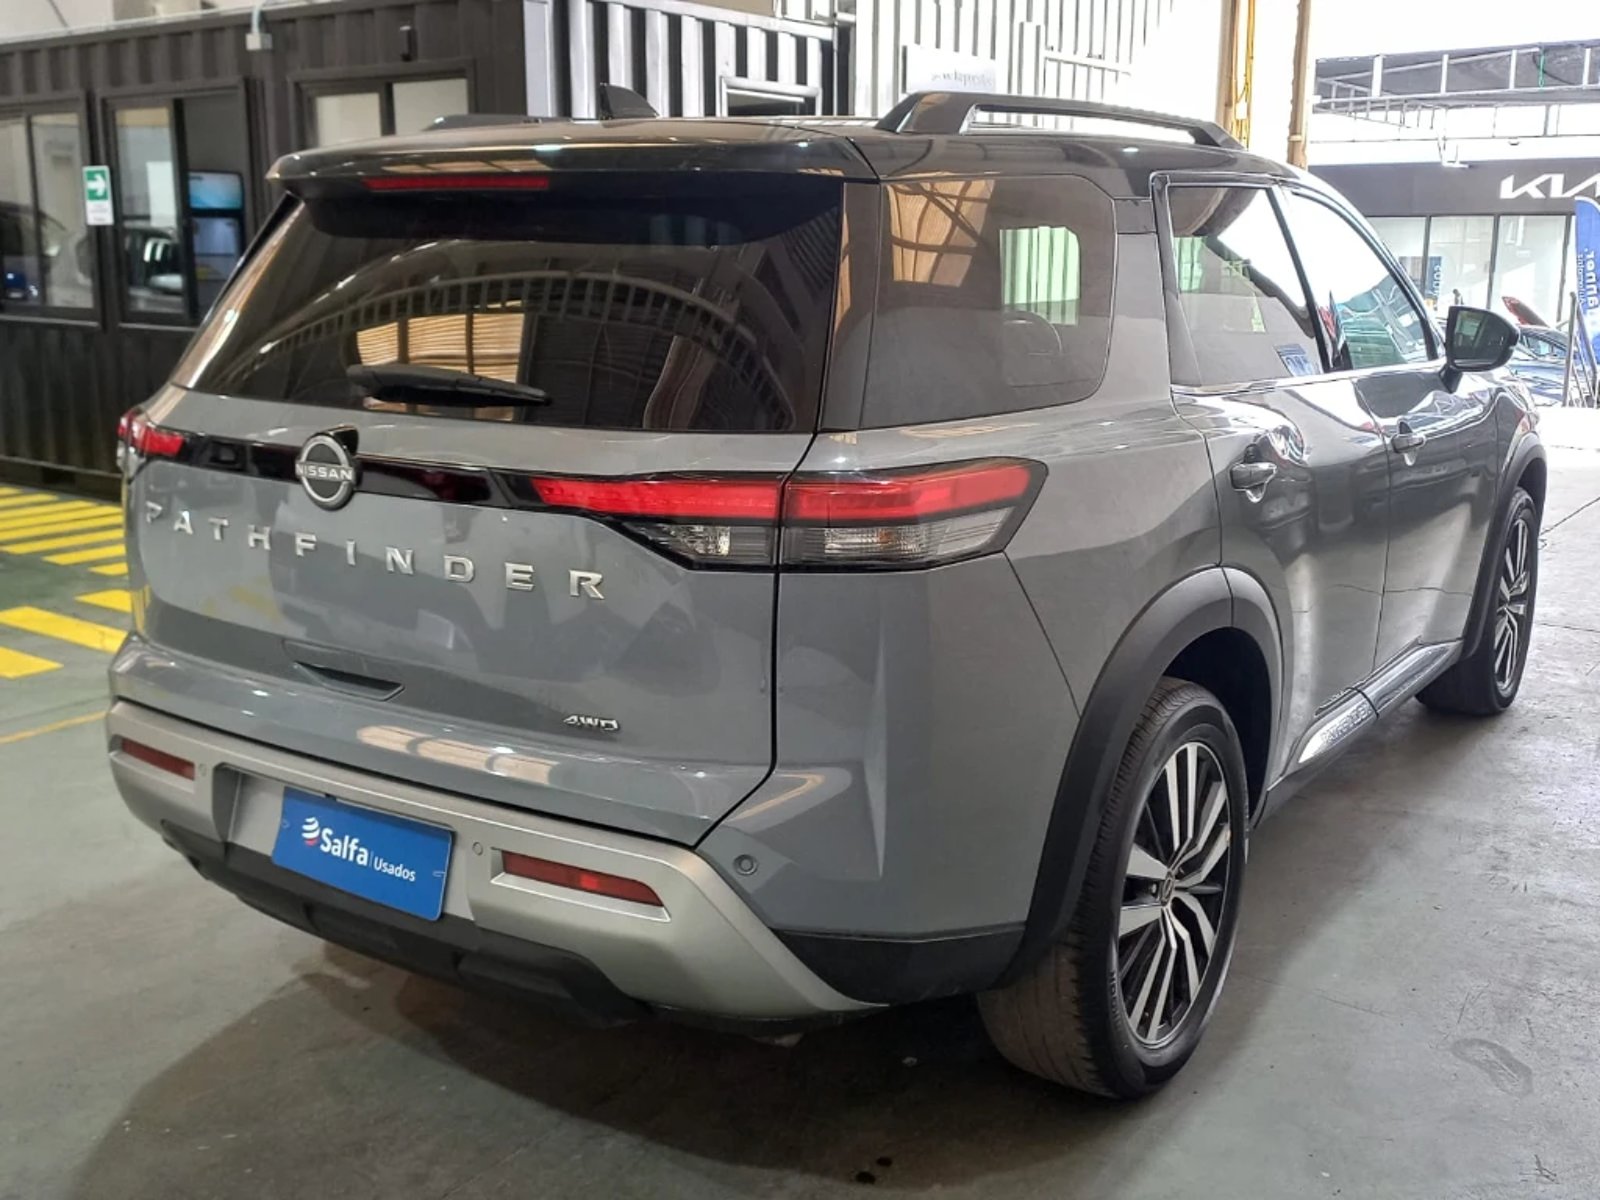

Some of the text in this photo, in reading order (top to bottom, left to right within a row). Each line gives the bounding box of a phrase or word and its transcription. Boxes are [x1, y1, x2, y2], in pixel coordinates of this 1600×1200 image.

[295, 463, 353, 480] NISSAN
[146, 501, 605, 599] PATHFINDER
[563, 714, 619, 731] 4WD
[320, 828, 416, 882] Salfa Usados
